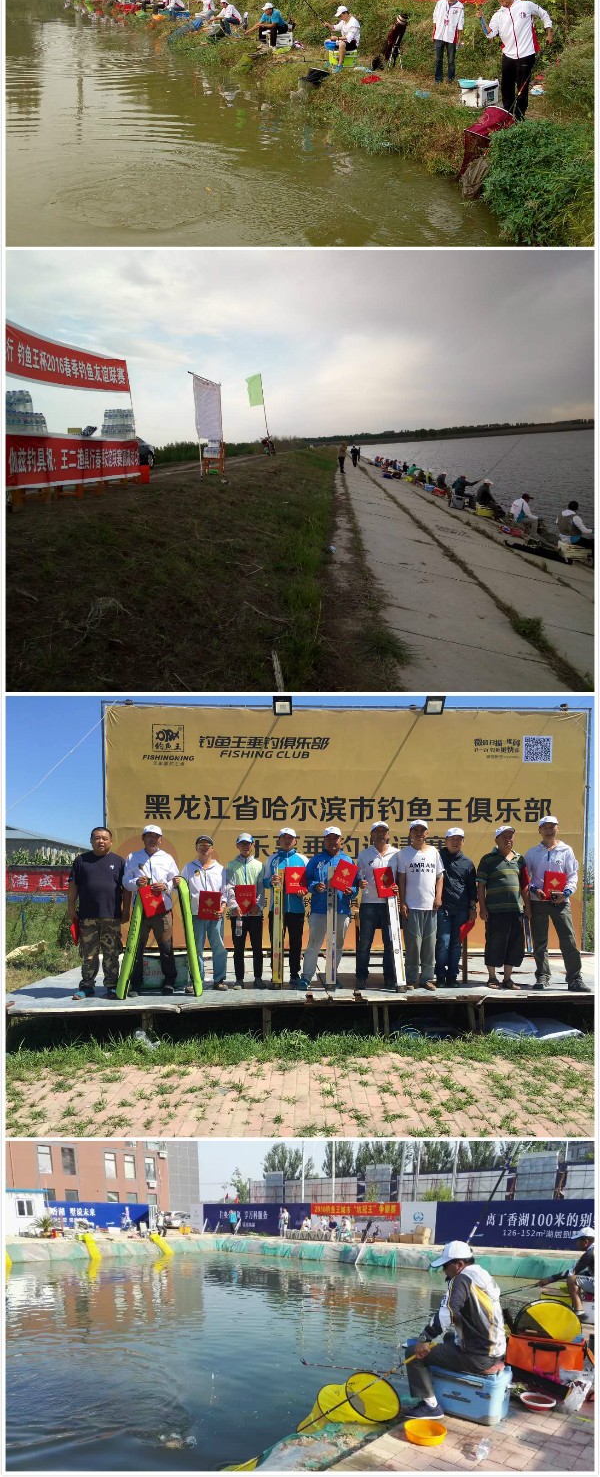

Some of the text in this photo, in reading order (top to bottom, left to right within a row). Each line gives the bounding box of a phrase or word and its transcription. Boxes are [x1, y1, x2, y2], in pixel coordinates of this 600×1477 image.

[199, 735, 331, 750] 钓鱼王垂钓俱乐部
[219, 750, 310, 759] FISHING CLUB
[144, 794, 552, 823] 黑龙江省哈尔滨市钓鱼王俱乐部
[486, 1212, 595, 1227] 离丁香湖100米的别
